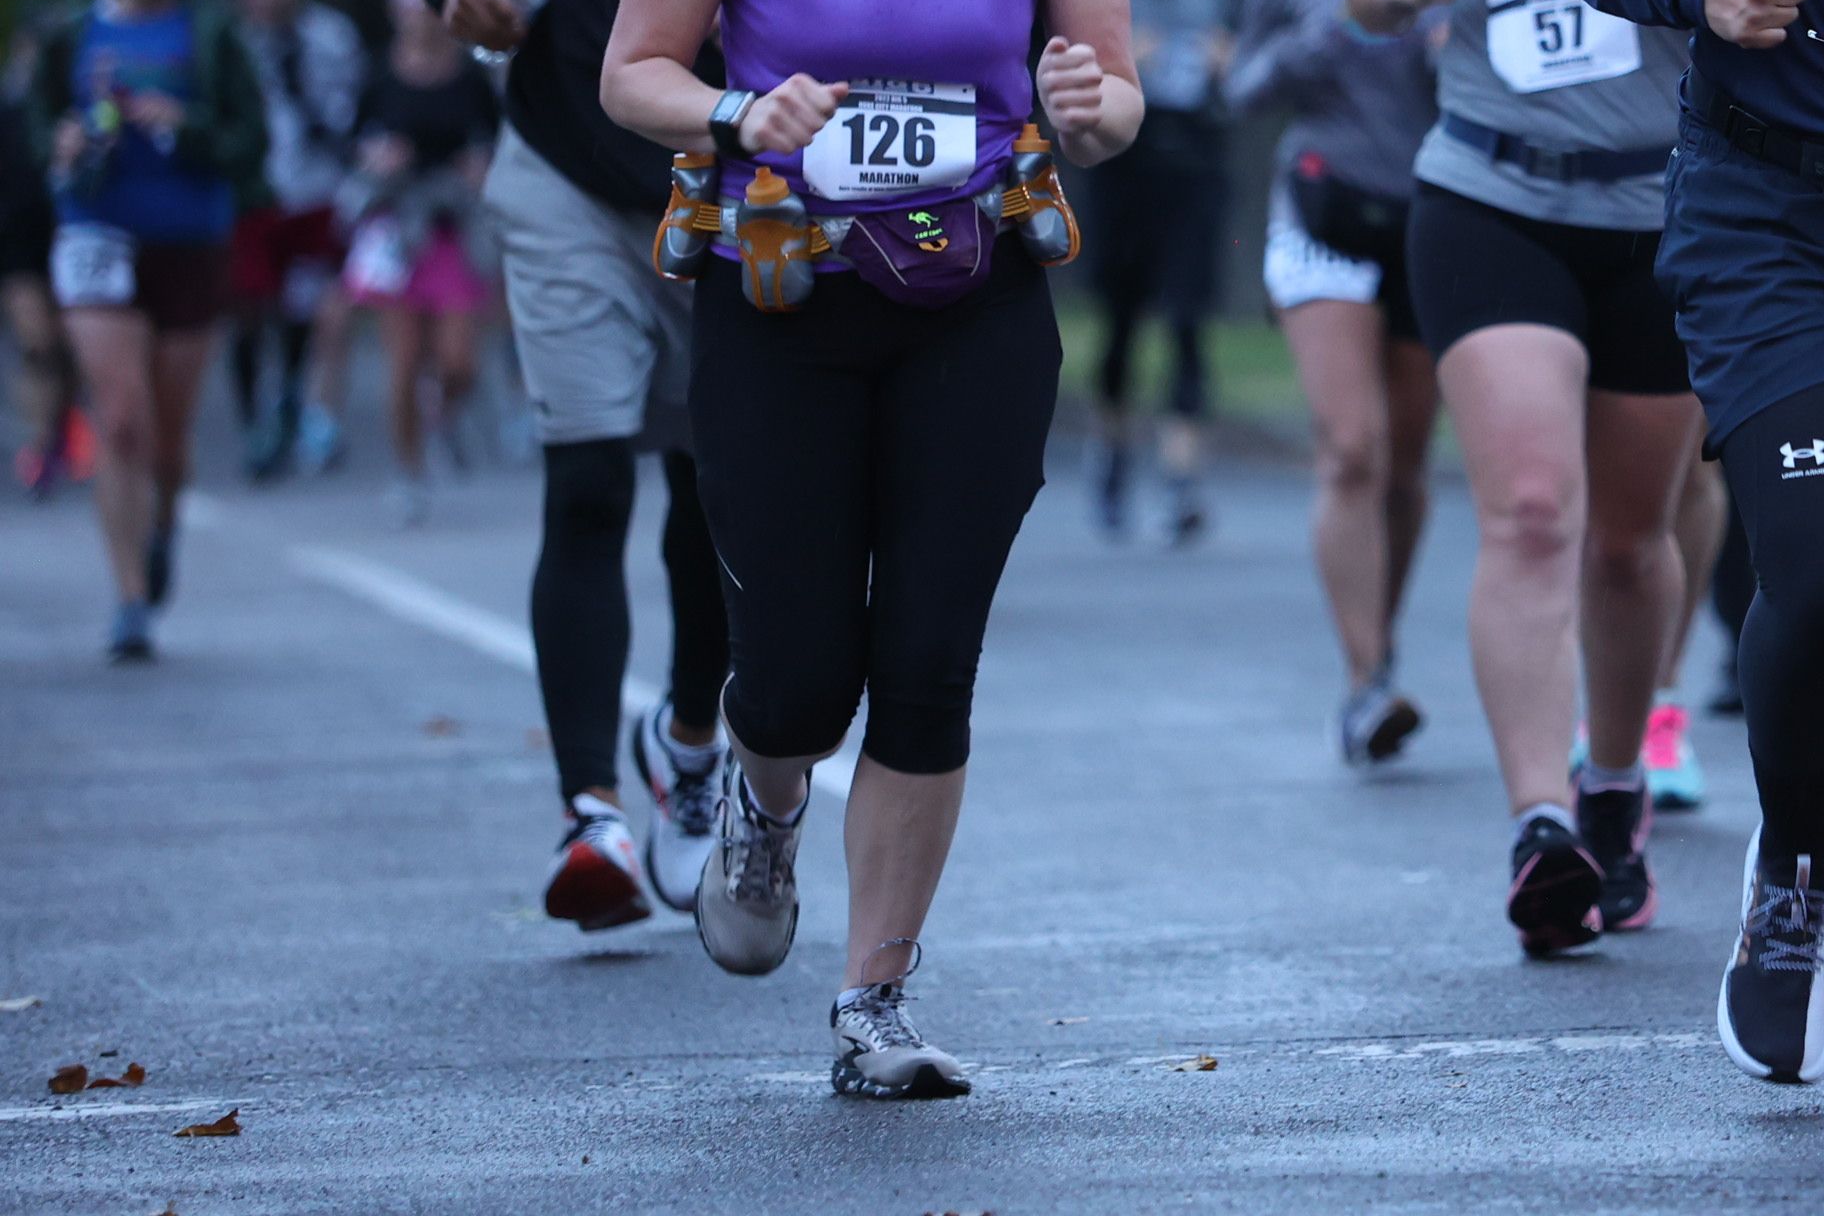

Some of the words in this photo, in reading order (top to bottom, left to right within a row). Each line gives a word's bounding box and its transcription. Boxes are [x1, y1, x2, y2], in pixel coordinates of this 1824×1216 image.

[1535, 5, 1583, 53] 57
[842, 113, 936, 168] 126
[859, 172, 920, 185] MARATHON
